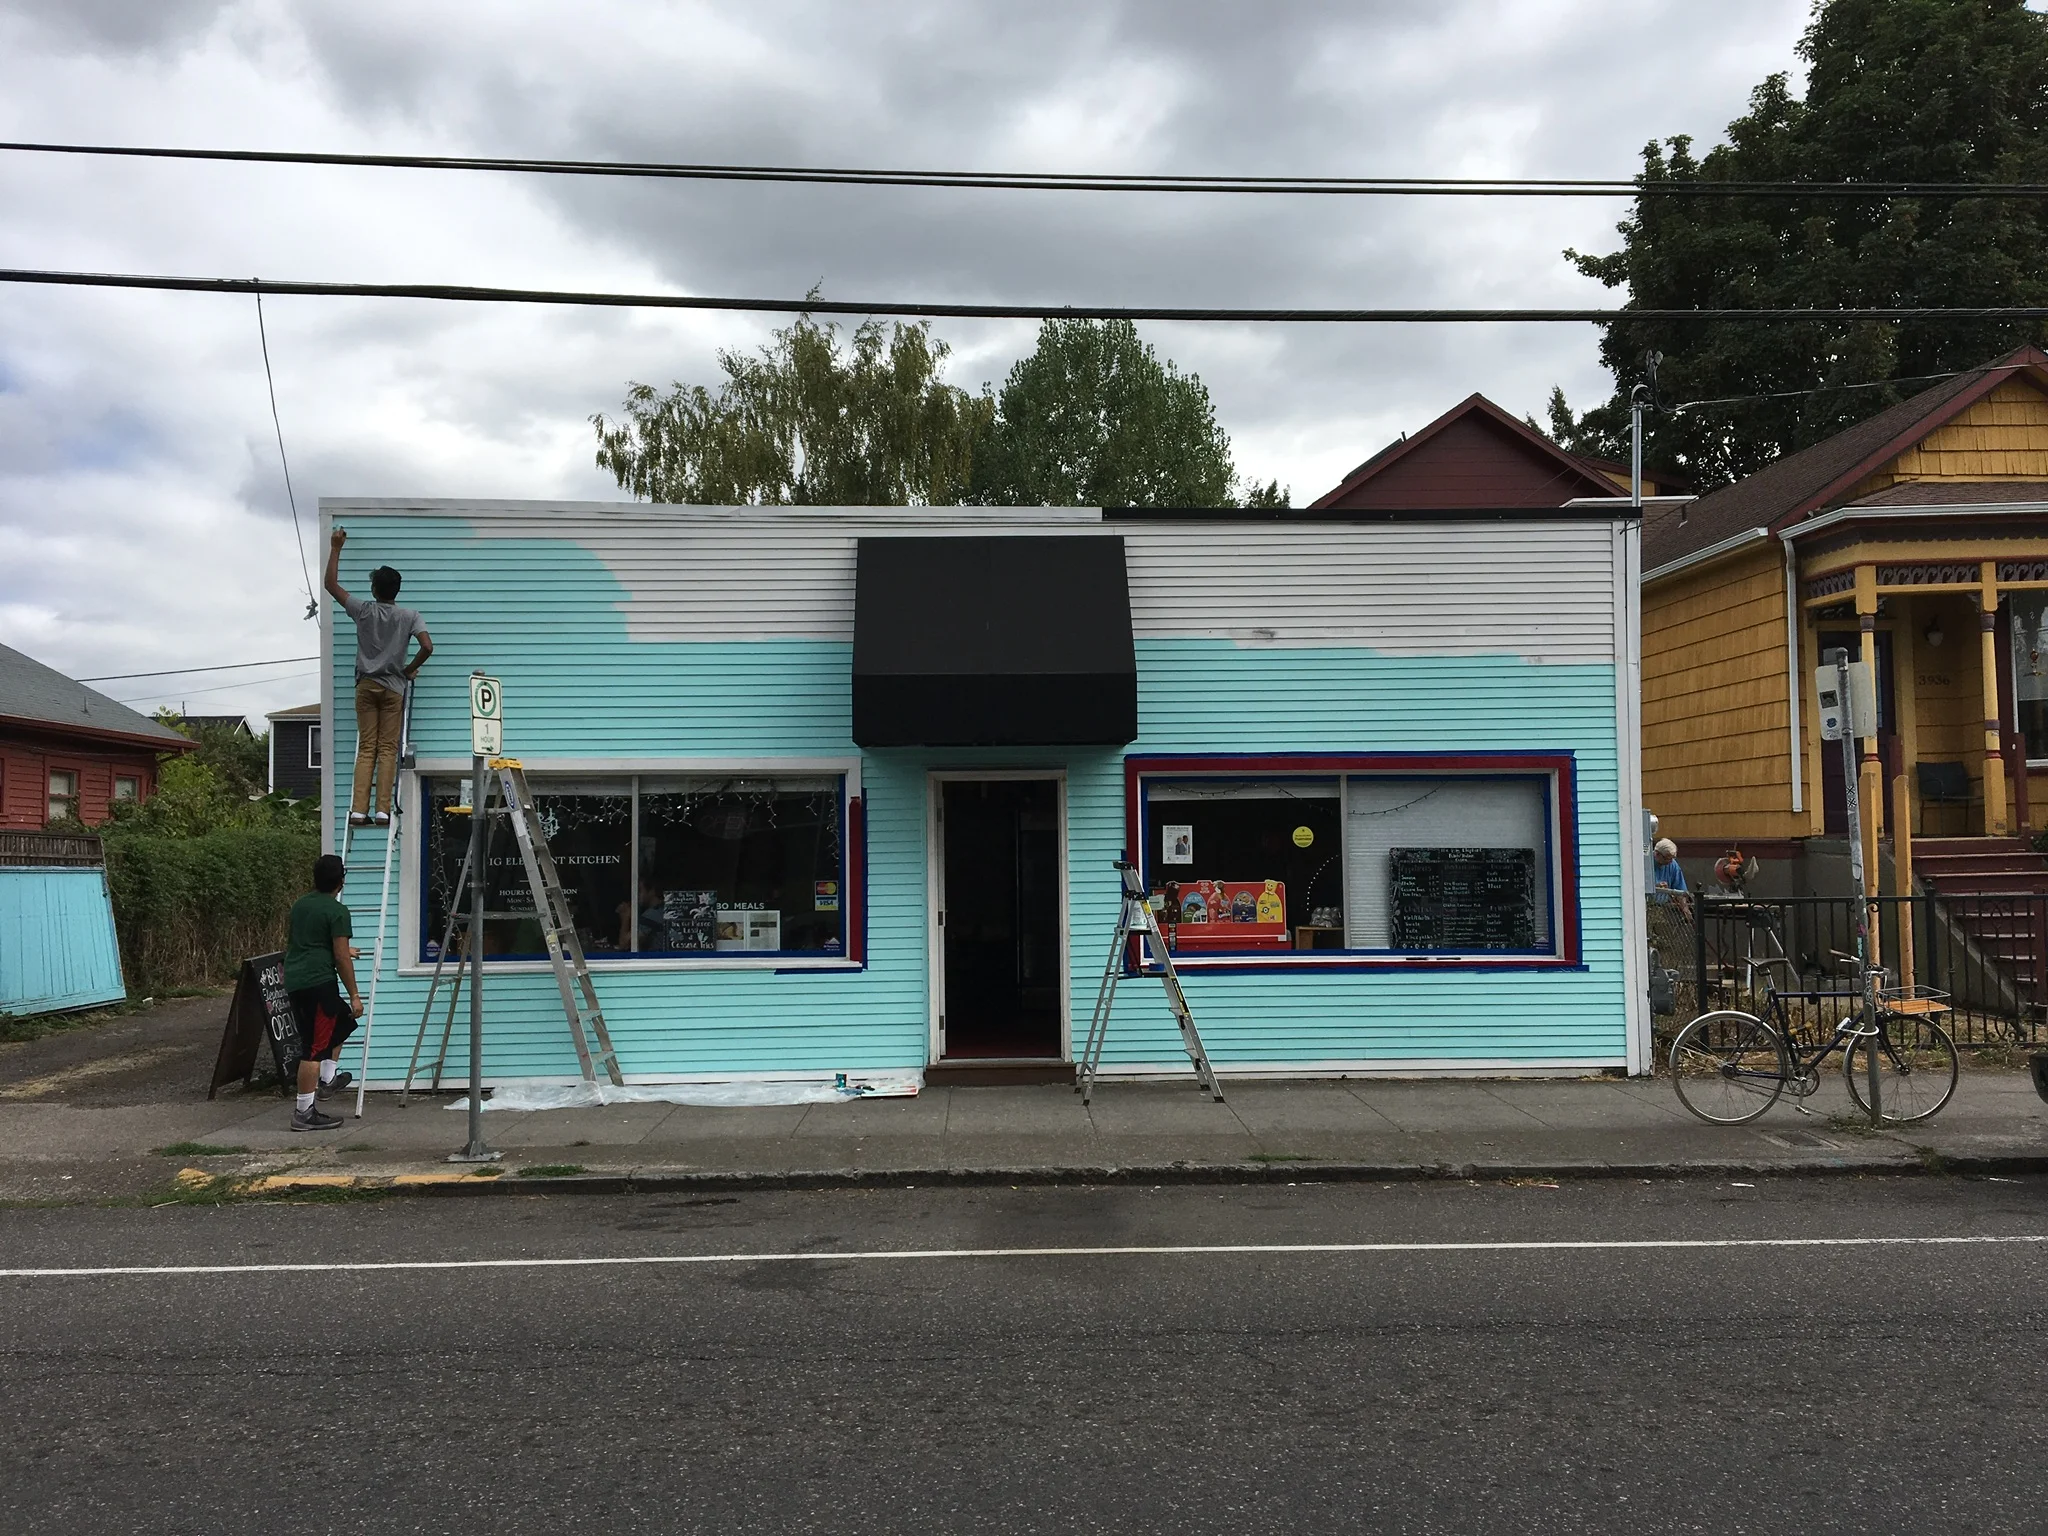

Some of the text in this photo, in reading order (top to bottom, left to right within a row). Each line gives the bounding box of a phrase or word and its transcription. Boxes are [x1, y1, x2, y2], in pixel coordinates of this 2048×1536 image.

[481, 689, 492, 709] P
[484, 723, 489, 735] 1
[480, 736, 495, 744] HOUR
[488, 857, 502, 866] IG
[568, 855, 621, 865] KITCHEN
[734, 902, 765, 910] MEALS
[266, 966, 280, 986] BIG
[272, 1010, 299, 1041] OPEN
